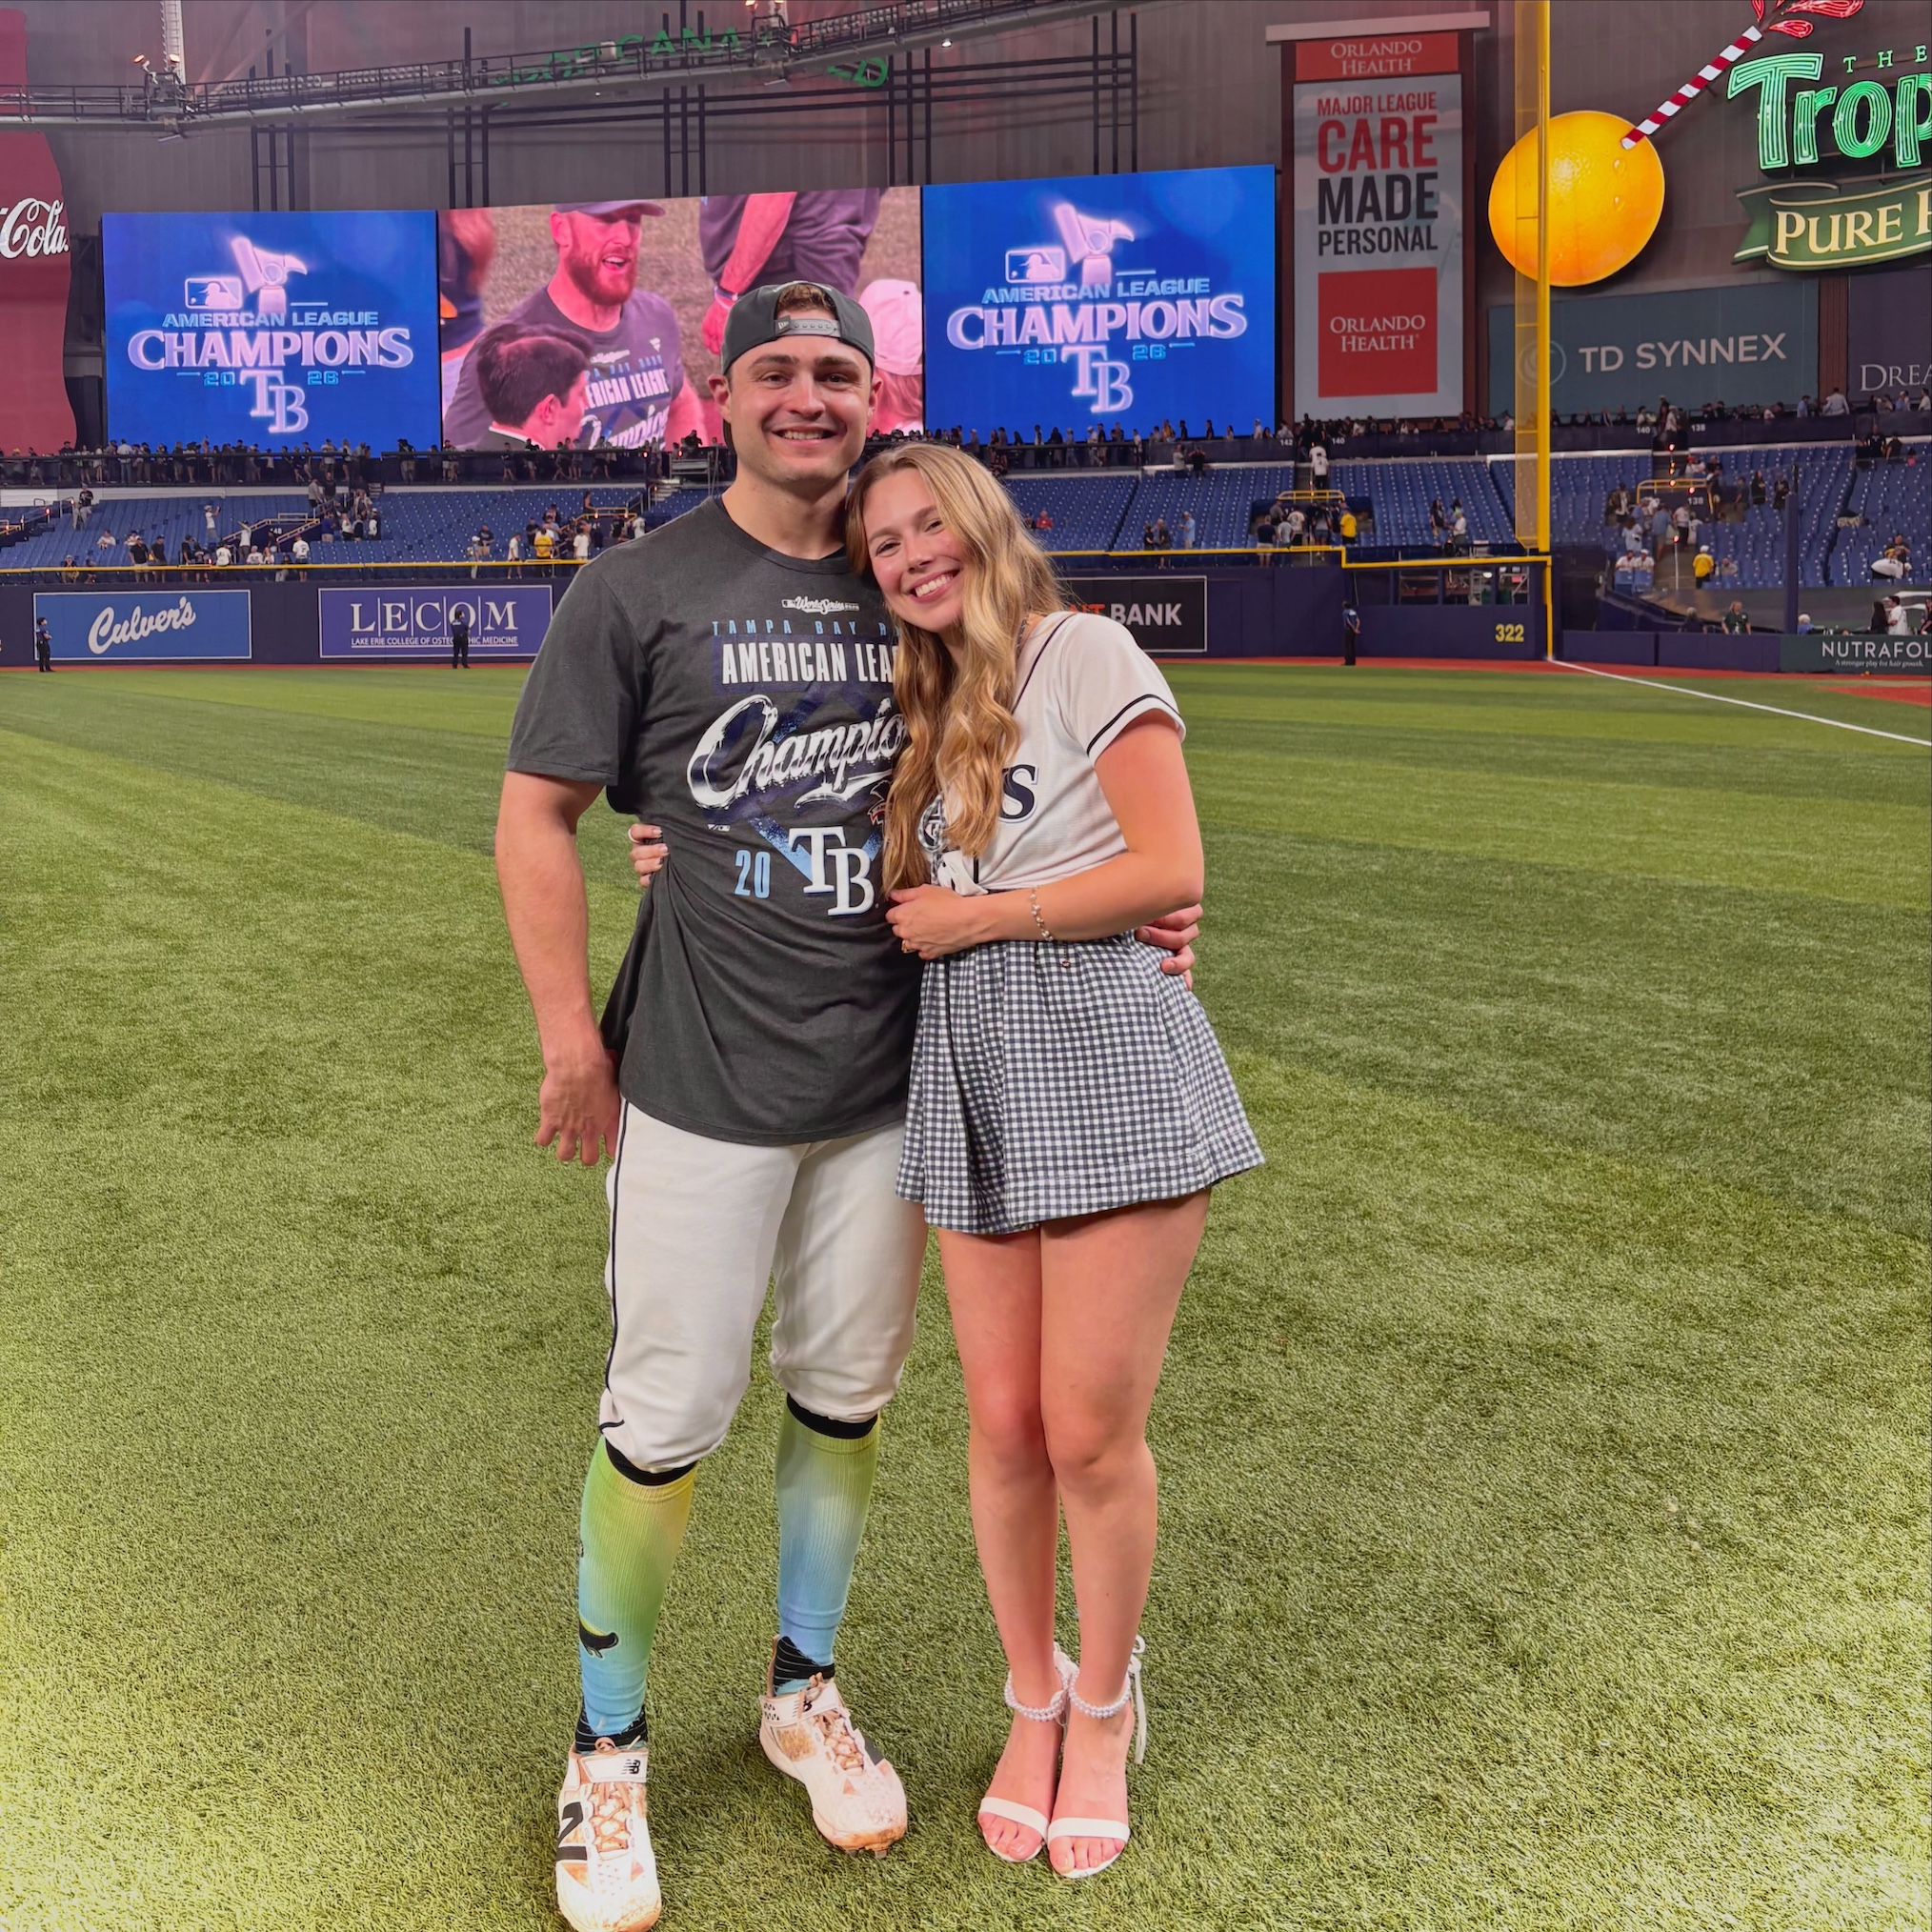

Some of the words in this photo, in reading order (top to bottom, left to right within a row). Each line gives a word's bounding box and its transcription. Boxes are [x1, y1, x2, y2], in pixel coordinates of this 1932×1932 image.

[1330, 40, 1423, 58] ORLANDO
[1341, 58, 1413, 75] HEALTH
[1843, 45, 1928, 73] THE
[1318, 96, 1374, 116] MAJOR
[1378, 91, 1438, 112] LEAGUE
[1318, 114, 1438, 173] CARE
[1318, 171, 1439, 225] MADE
[1318, 225, 1439, 256] PERSONAL
[1774, 203, 1903, 255] PURE
[981, 283, 1111, 304] AMERICAN
[1117, 278, 1210, 297] LEAGUE
[162, 312, 285, 328] AMERICAN
[292, 312, 378, 326] LEAGUE
[946, 293, 1248, 350] CHAMPIONS
[1330, 314, 1426, 333] ORLANDO
[128, 327, 414, 371] CHAMPIONS
[1340, 334, 1415, 352] HEALTH
[1578, 346, 1624, 372] TD
[1636, 332, 1787, 369] SYNNEX
[1060, 345, 1134, 413] TB
[239, 370, 309, 433] TB
[88, 595, 196, 654] Culver's
[712, 619, 792, 635] TAMPA
[815, 620, 857, 634] BAY
[1110, 603, 1182, 626] BANK
[1495, 624, 1524, 642] 322
[722, 642, 847, 684] AMERICAN
[855, 642, 898, 683] LEA
[687, 694, 907, 810] Champio
[734, 849, 771, 898] 20
[788, 826, 875, 916] TB
